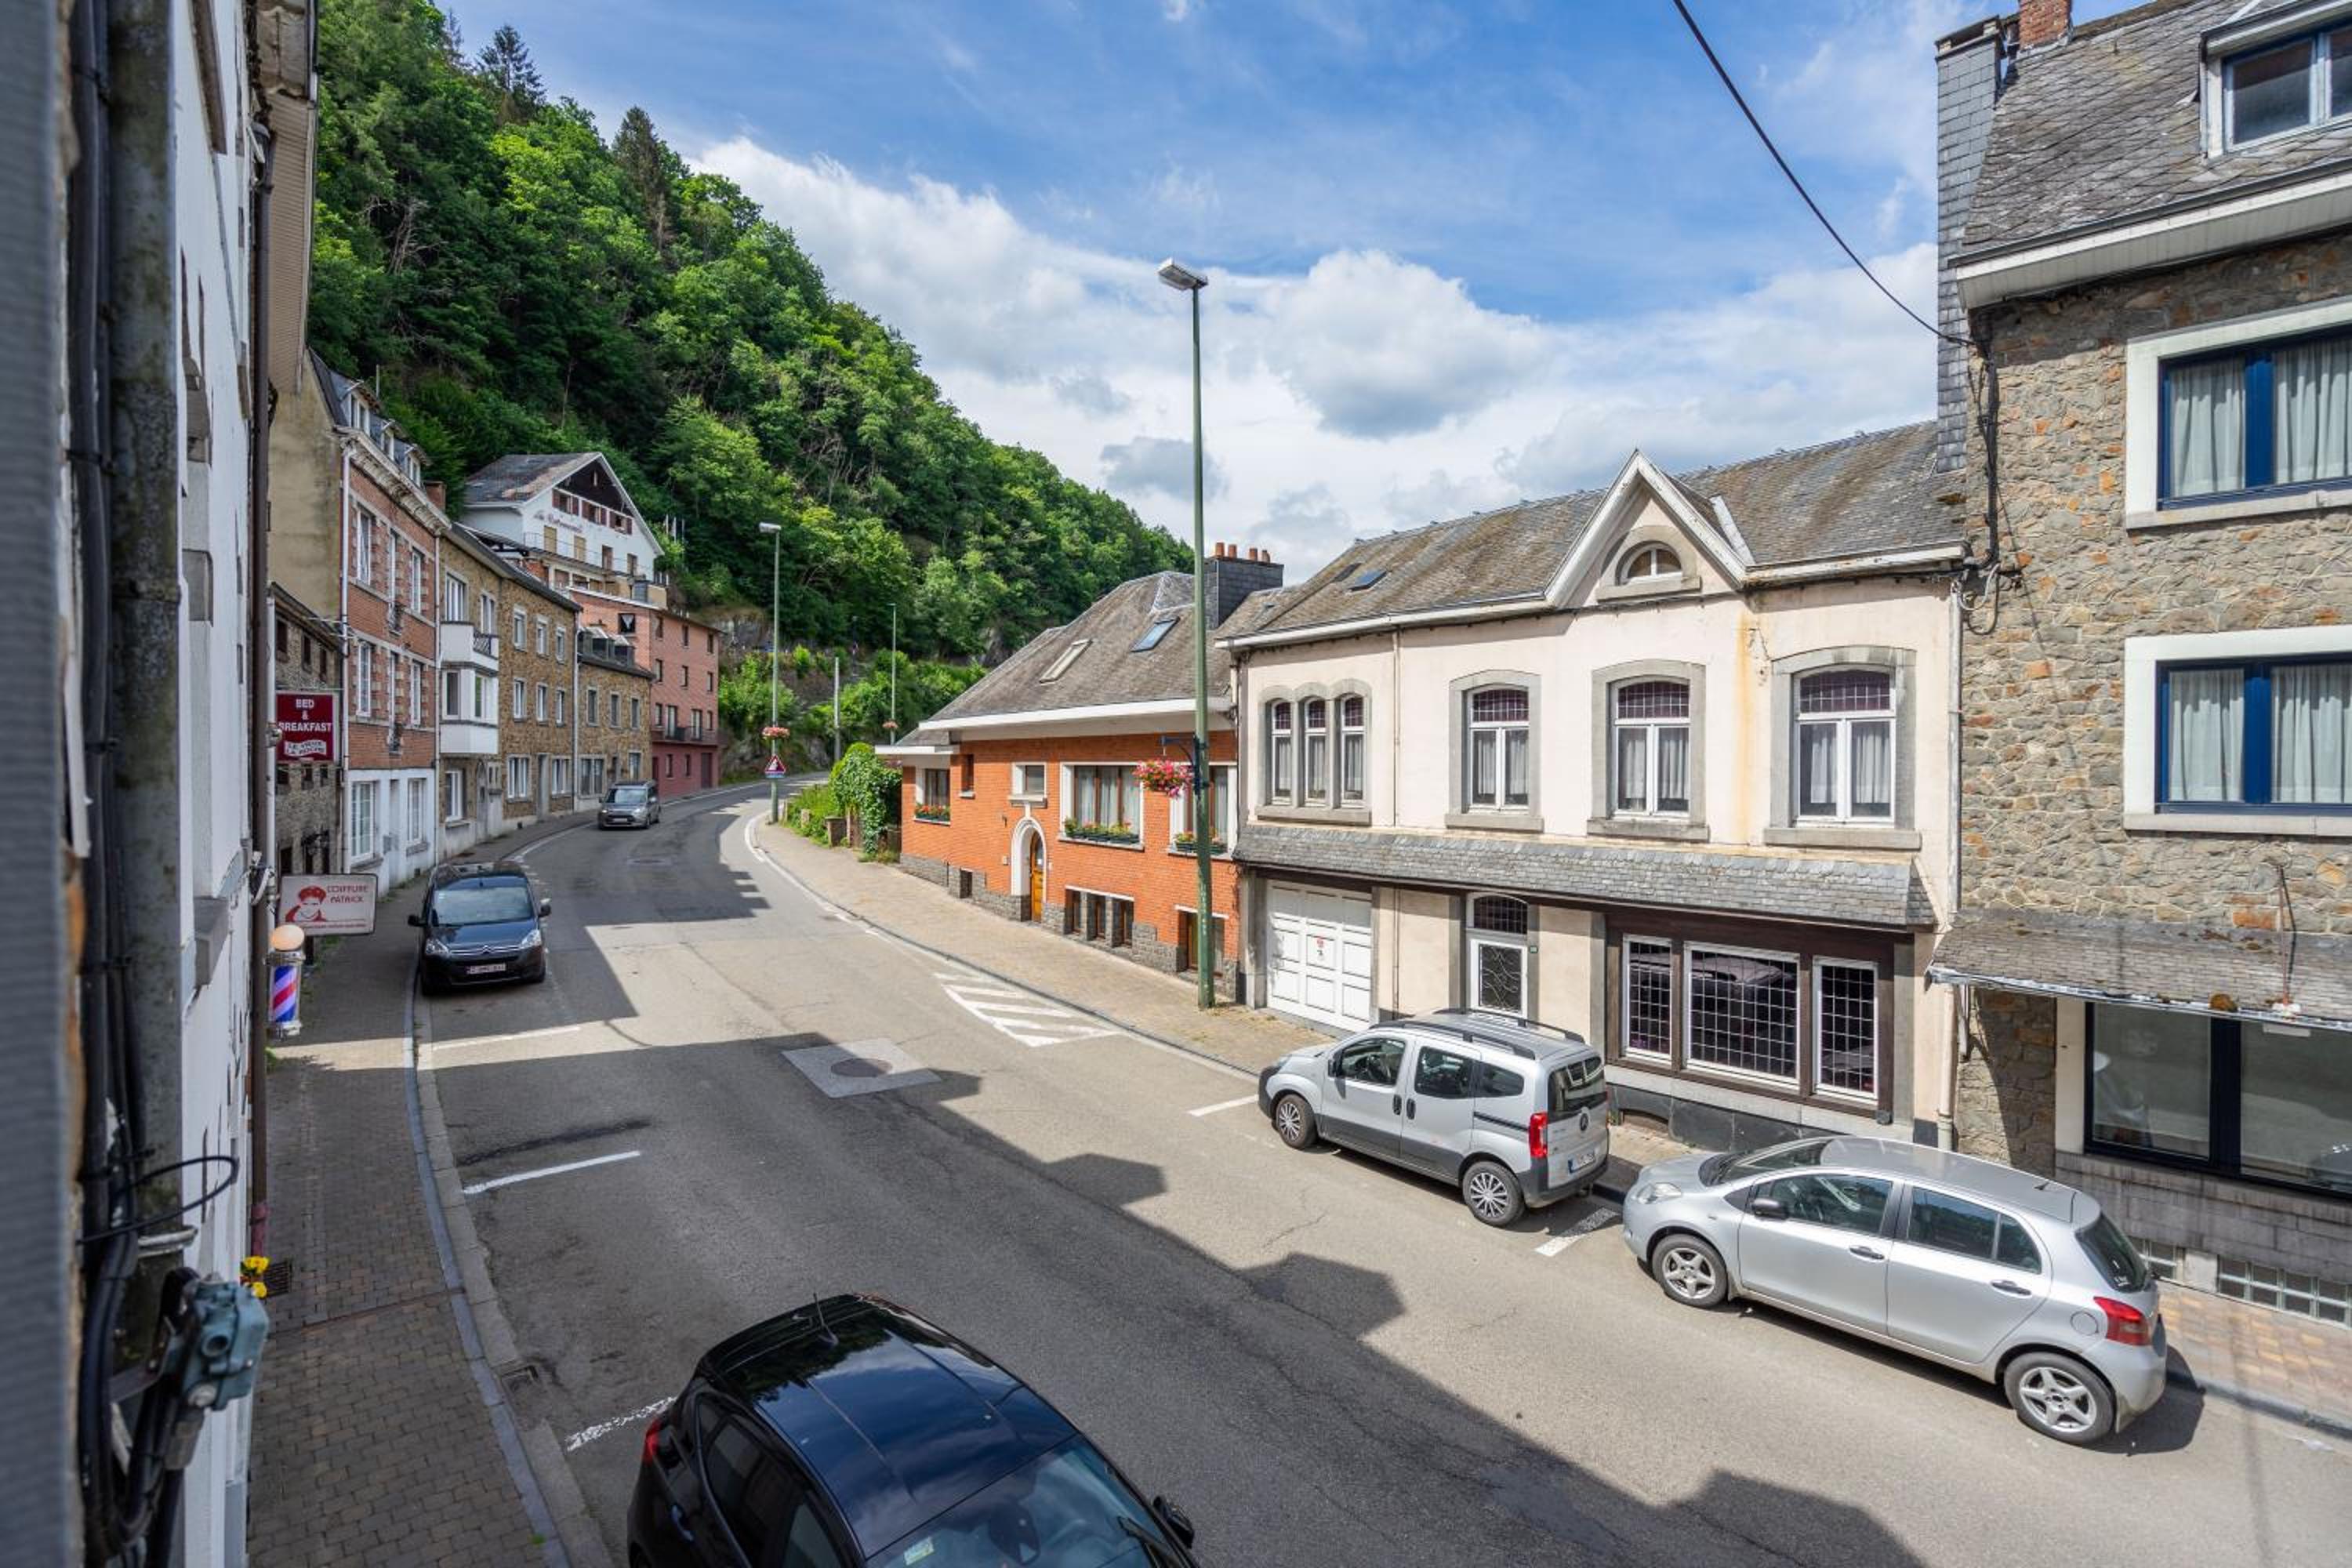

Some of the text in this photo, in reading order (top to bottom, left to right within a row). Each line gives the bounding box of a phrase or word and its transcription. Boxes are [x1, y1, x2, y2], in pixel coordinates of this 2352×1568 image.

[296, 699, 314, 709] BED
[302, 710, 309, 720] &
[278, 722, 332, 732] BREAKFAST
[330, 895, 365, 904] PATRICK
